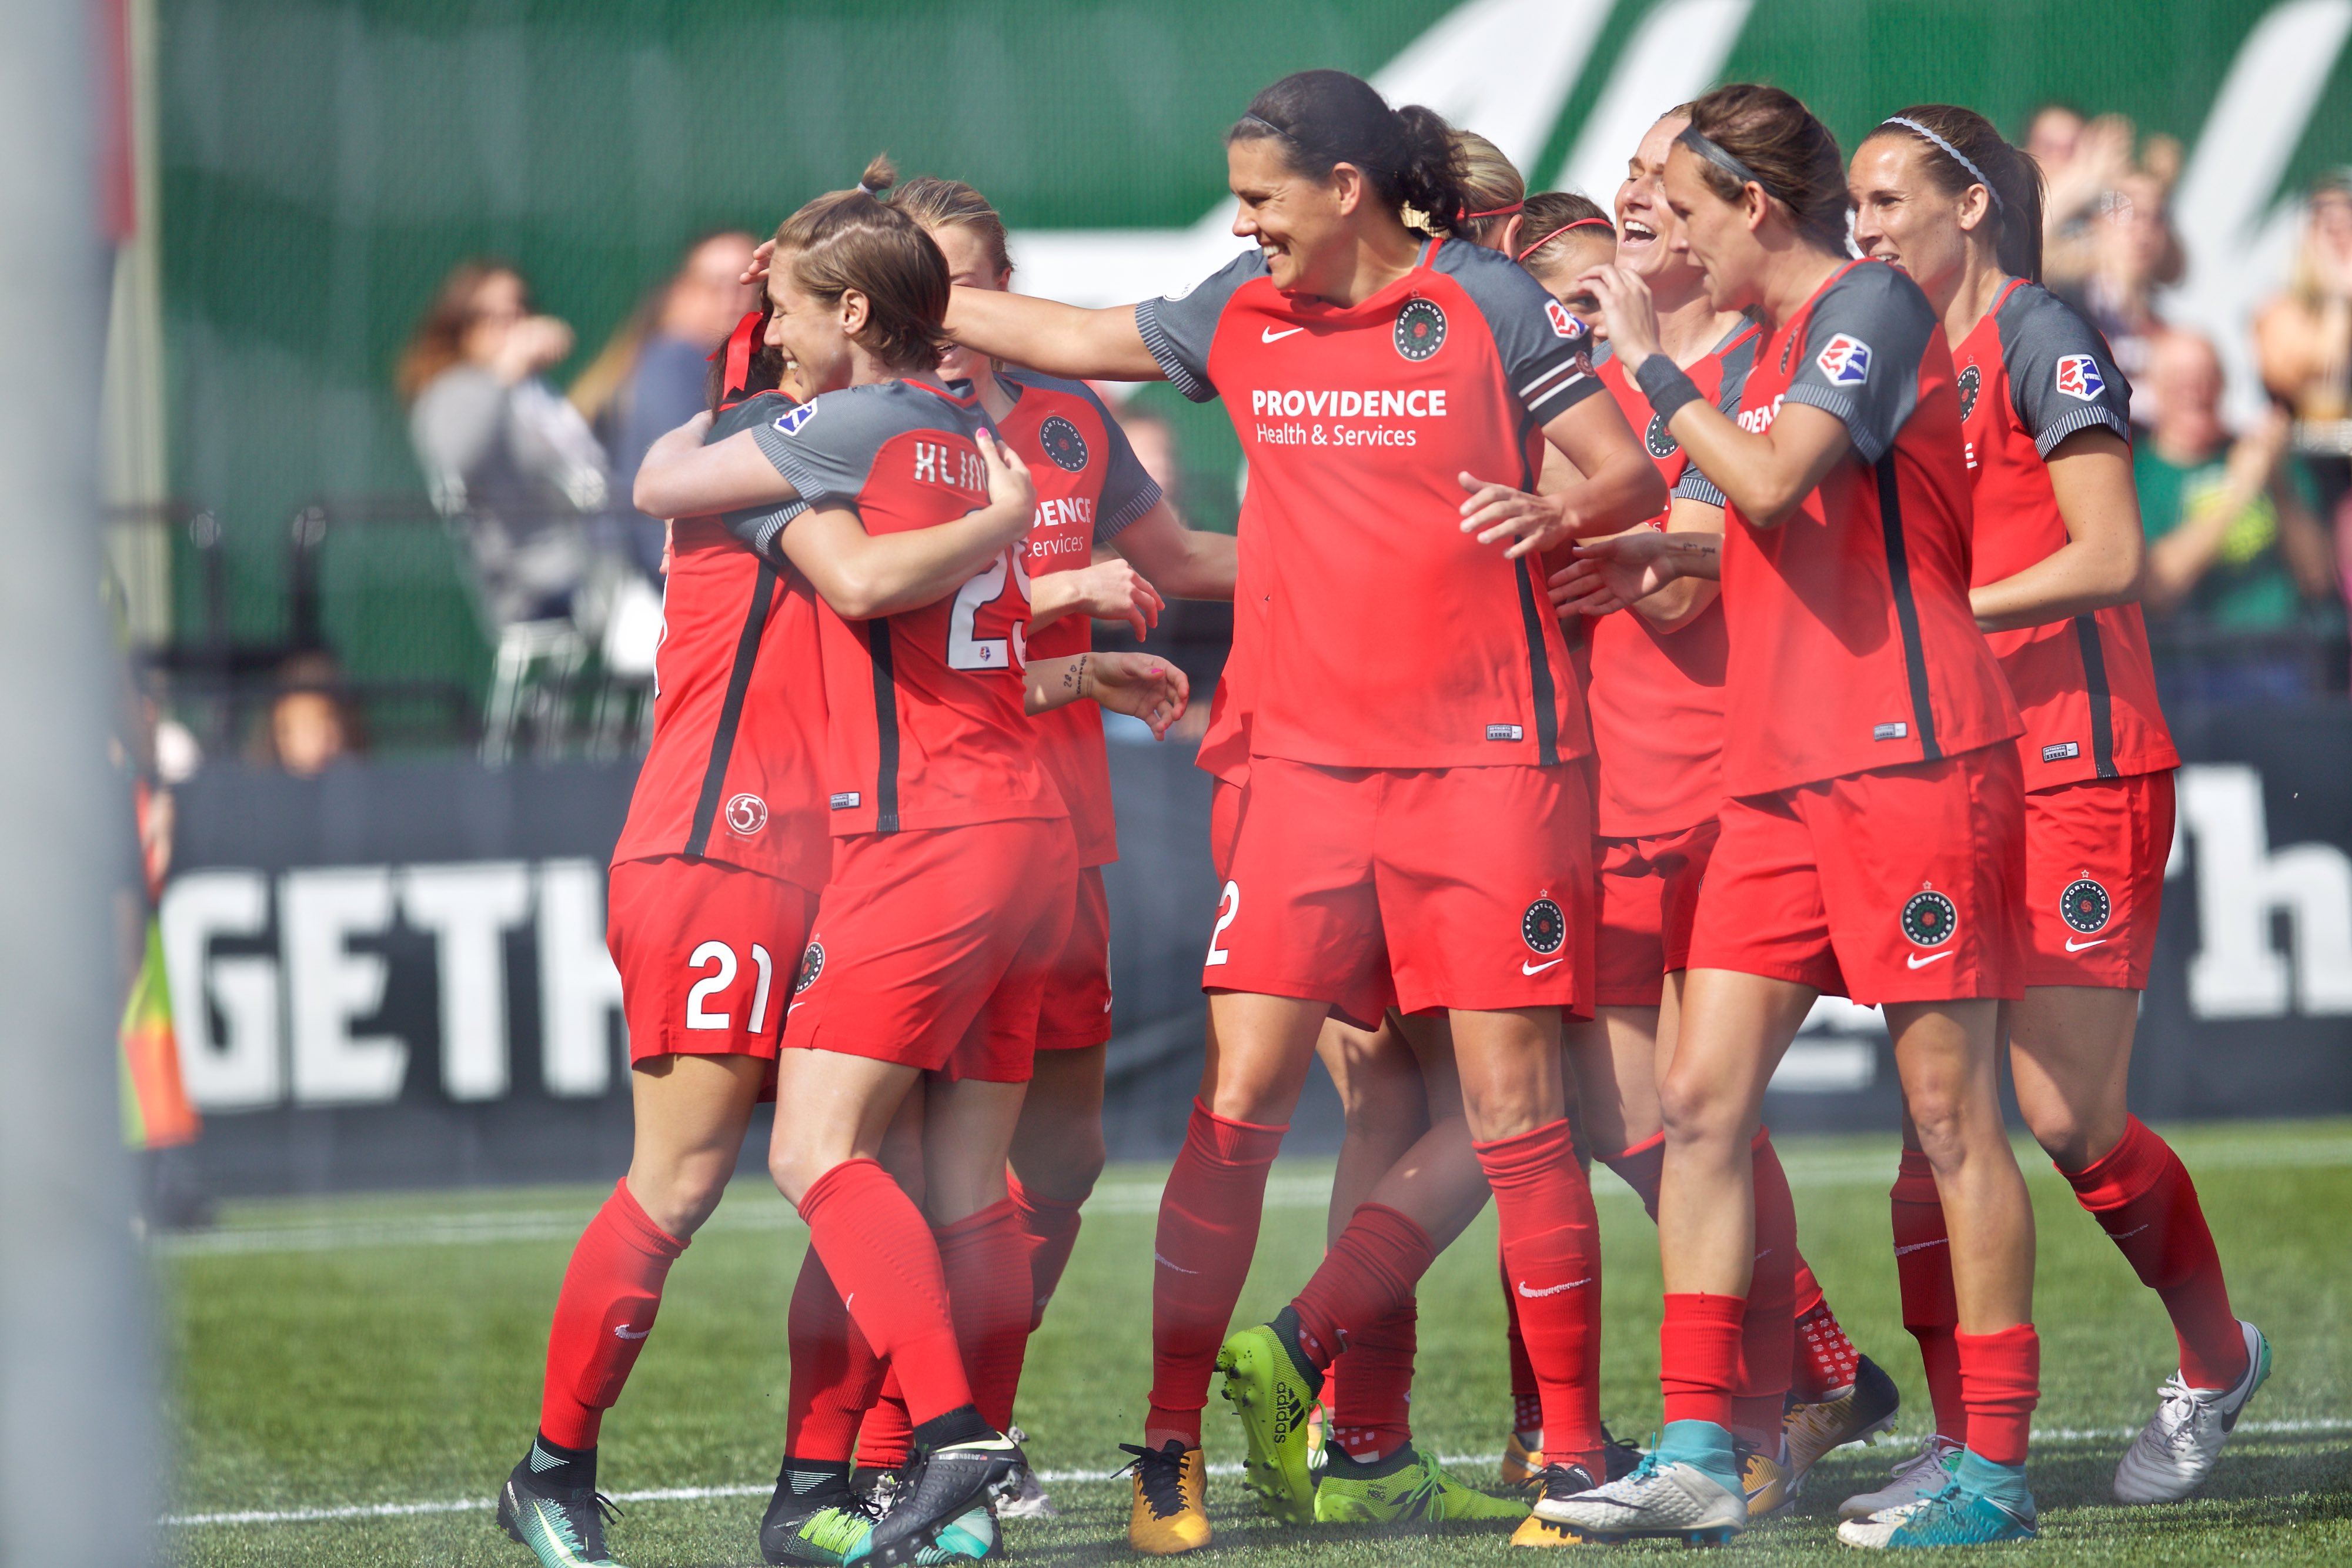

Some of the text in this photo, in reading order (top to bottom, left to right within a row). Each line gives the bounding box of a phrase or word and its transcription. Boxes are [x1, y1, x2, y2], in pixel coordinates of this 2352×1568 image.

[1399, 303, 1442, 325] PORTLAND
[1399, 336, 1442, 357] THORNS
[1252, 390, 1447, 417] PROVIDENCE
[1043, 420, 1079, 439] PORTLAND
[1256, 423, 1416, 446] Health & Services
[1649, 434, 1675, 454] THORN
[914, 442, 988, 492] KLIN
[1051, 450, 1085, 468] THORNS
[1028, 533, 1083, 557] ervices
[1064, 674, 1072, 687] 28
[733, 797, 760, 829] 5
[2065, 884, 2106, 902] PORTLAND
[1526, 903, 1562, 922] PORTLAND
[1906, 895, 1951, 915] PORTLAND
[2067, 913, 2106, 929] THORNS
[1528, 932, 1562, 950] THORNS
[686, 940, 772, 1034] 21
[1274, 1382, 1289, 1443] adidas
